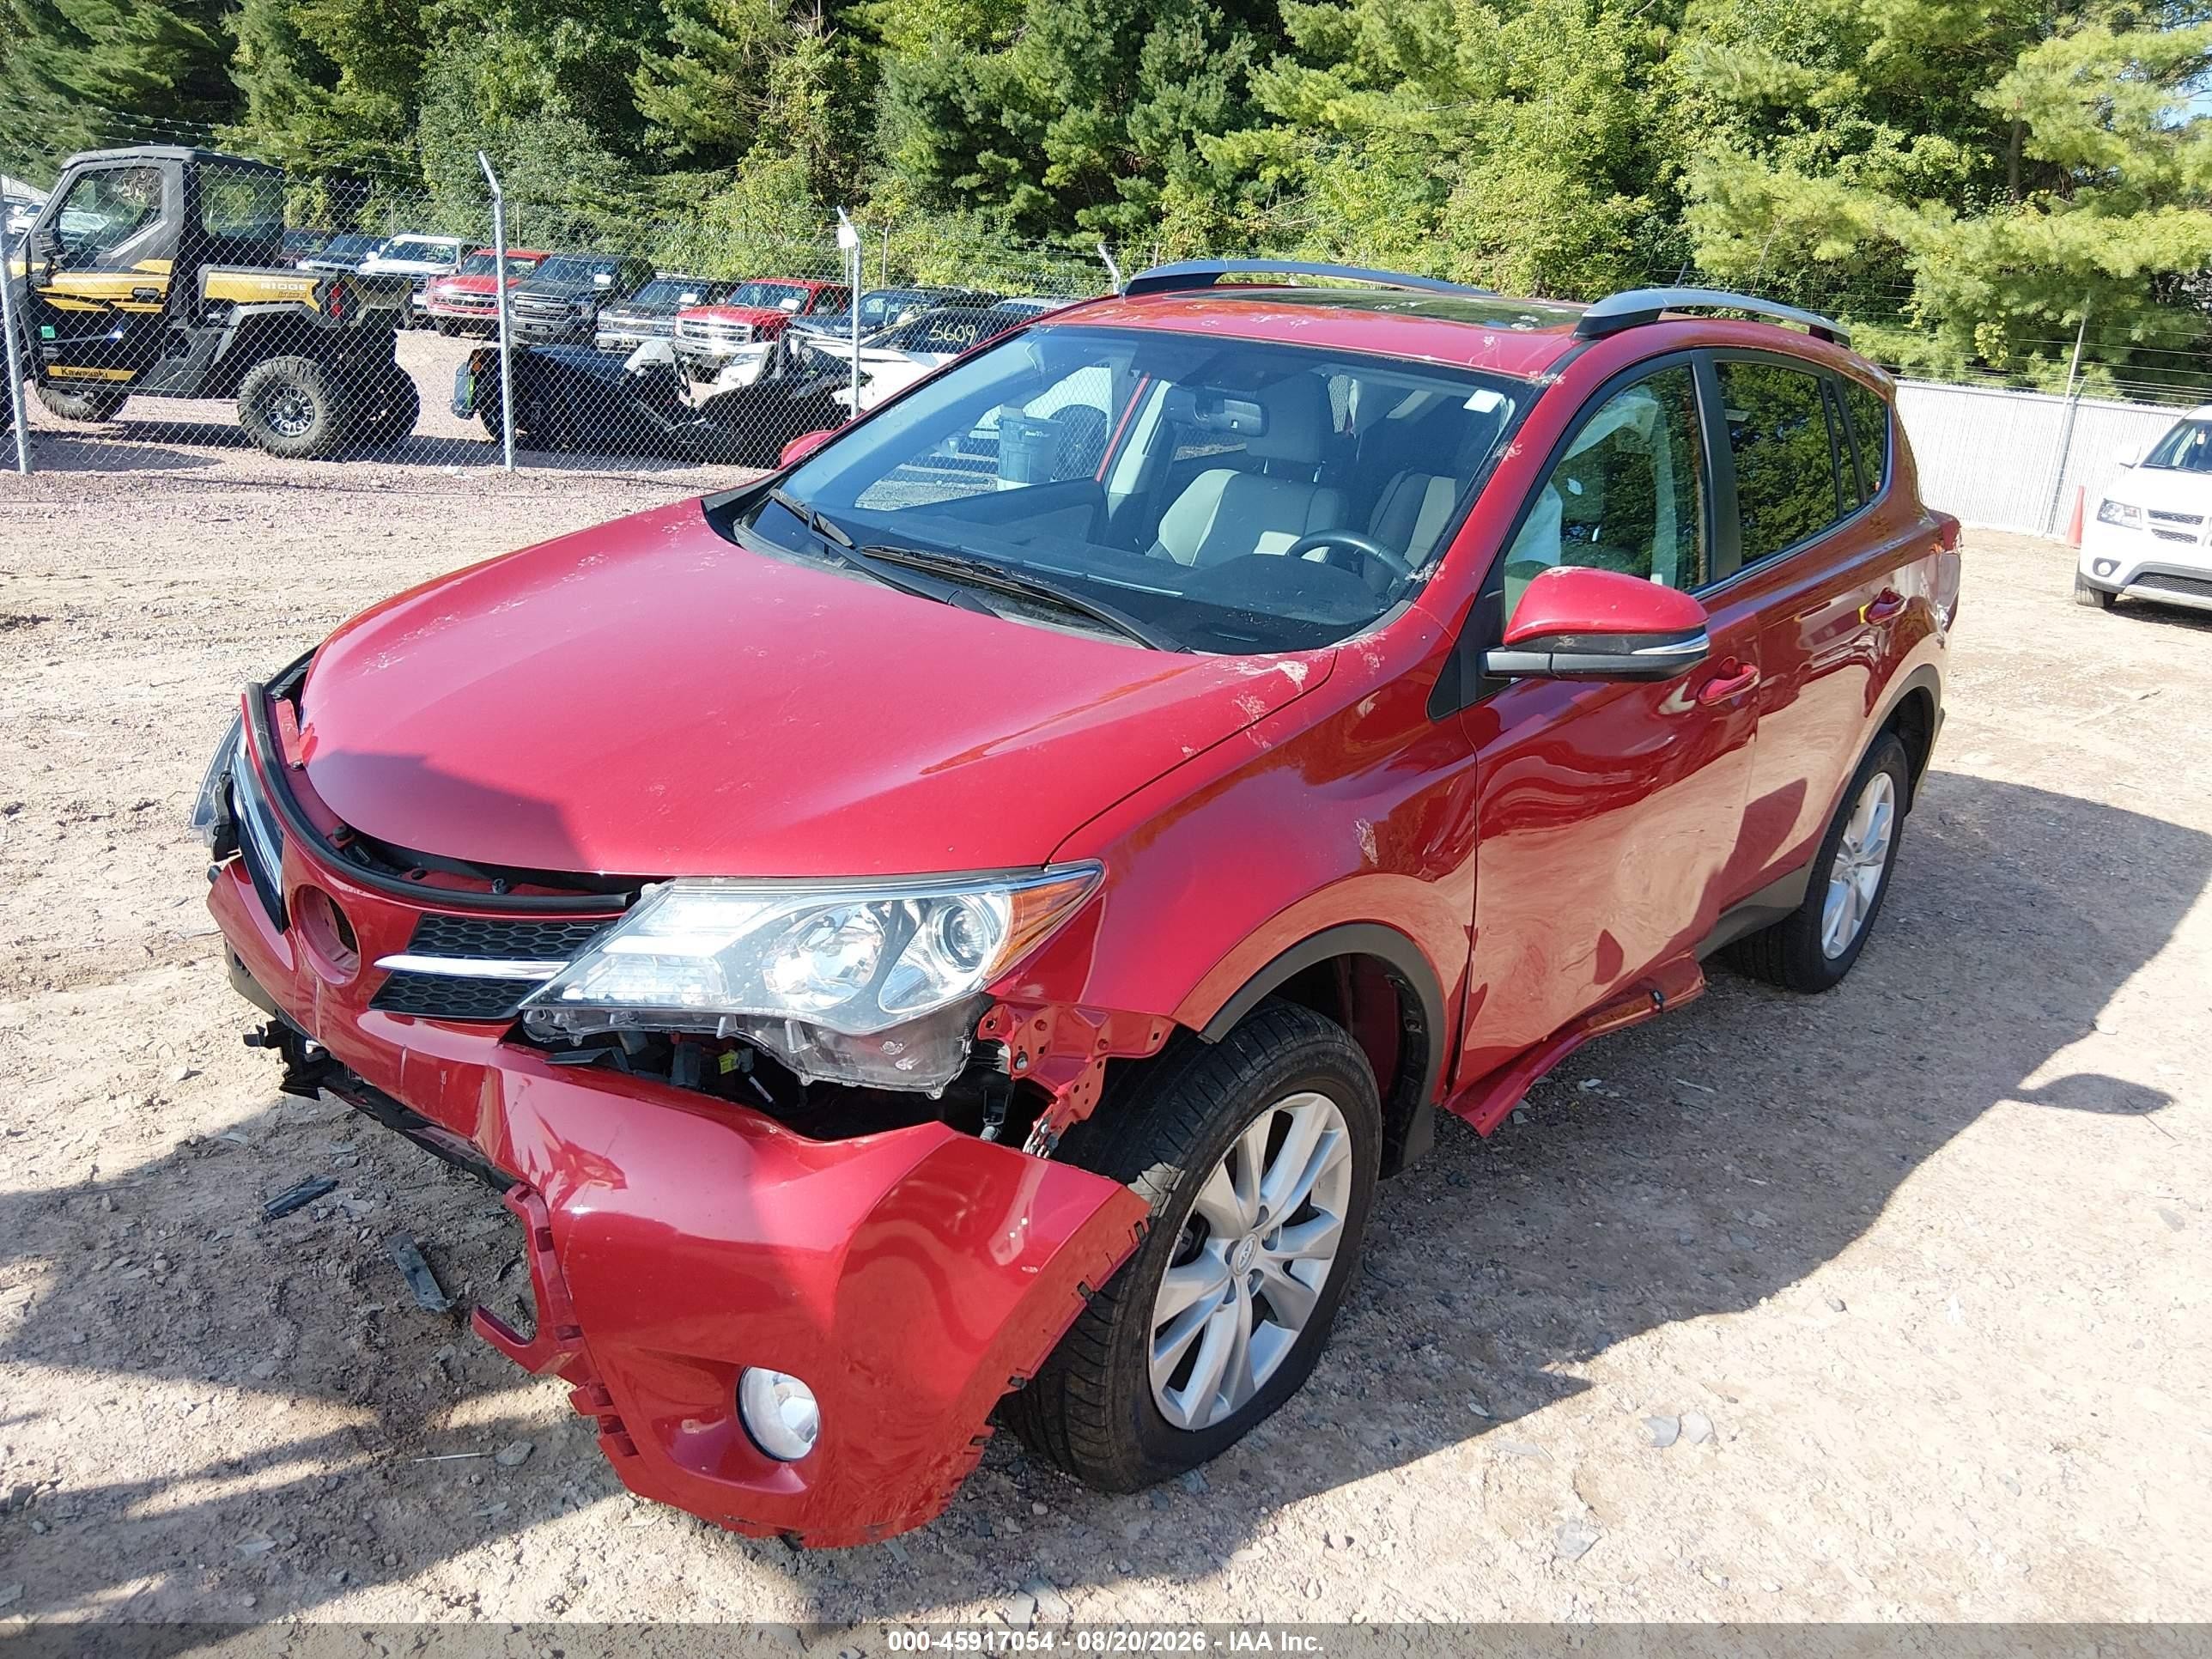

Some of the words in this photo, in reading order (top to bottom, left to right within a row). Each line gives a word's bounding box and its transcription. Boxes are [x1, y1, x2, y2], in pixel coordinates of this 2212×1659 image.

[260, 282, 307, 291] RIDGE
[928, 320, 976, 346] 5609
[60, 368, 108, 379] Kawasaki
